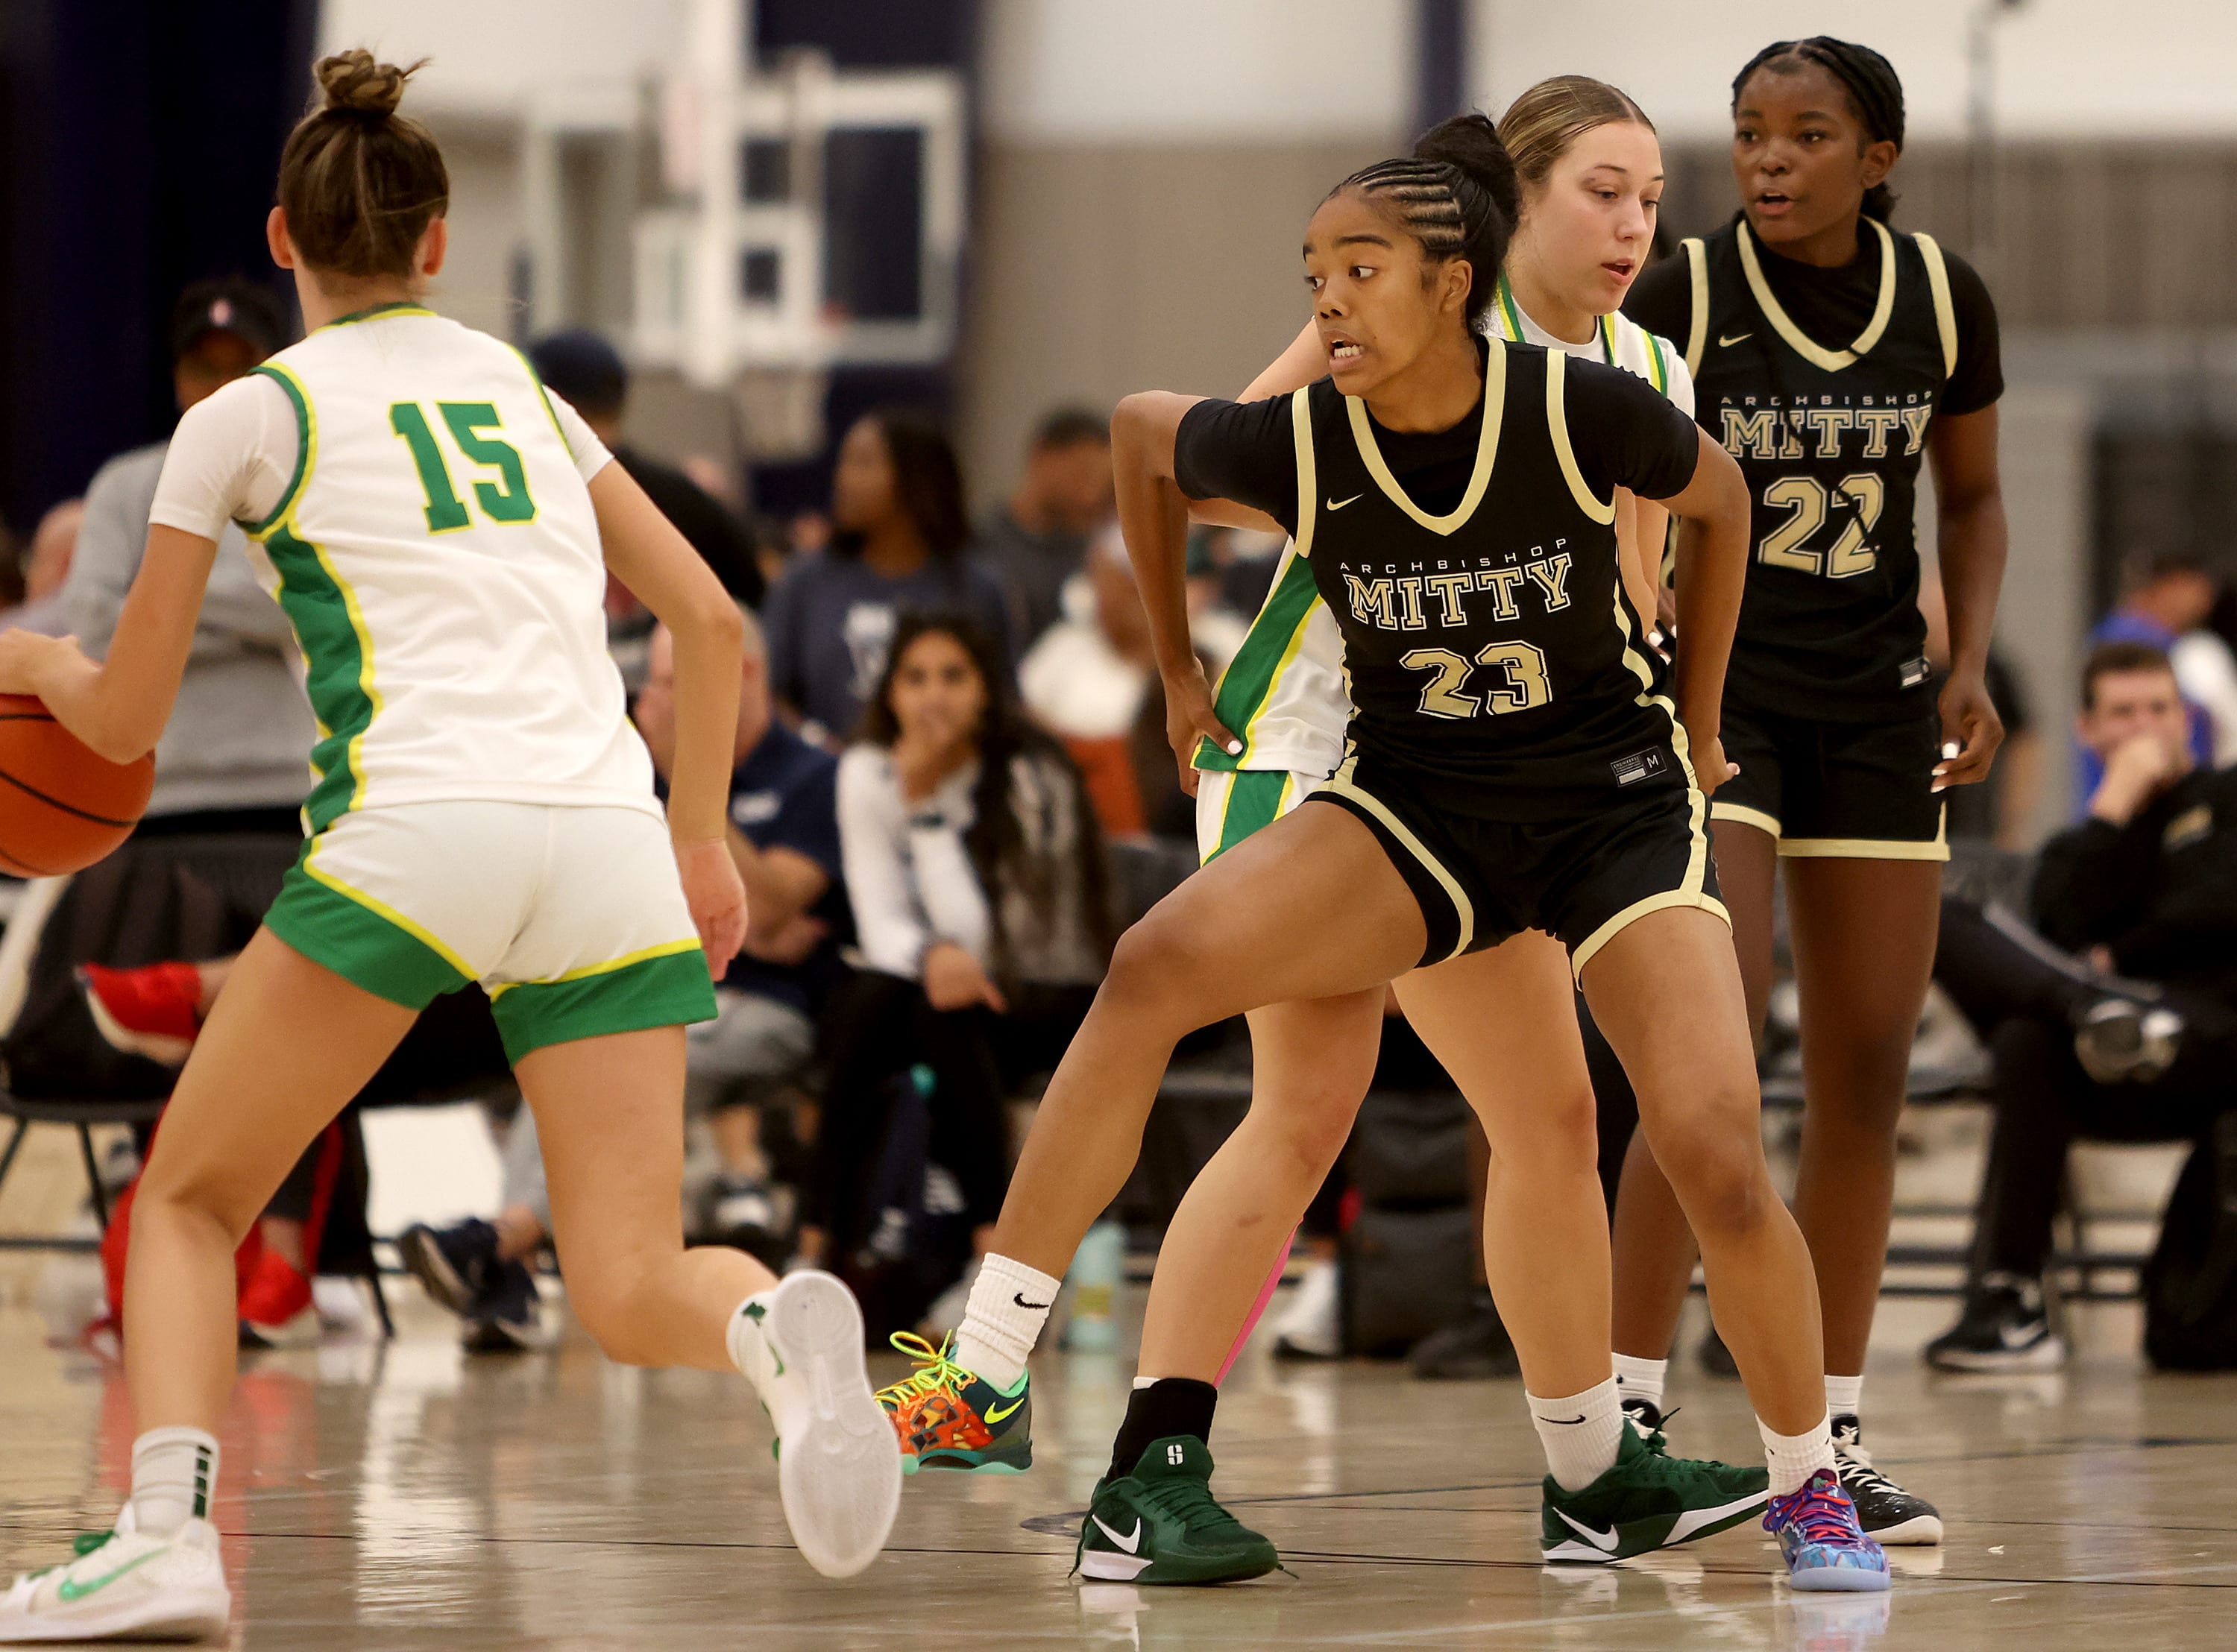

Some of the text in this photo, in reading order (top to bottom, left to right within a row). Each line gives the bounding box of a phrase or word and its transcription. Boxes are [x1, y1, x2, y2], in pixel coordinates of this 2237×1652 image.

[1720, 391, 1933, 406] ARCHBISHOP
[1720, 403, 1932, 460] MITTY
[387, 400, 541, 537] 15
[1339, 538, 1567, 574] ARCHBISHOP
[1758, 472, 1884, 578] 22
[1342, 552, 1573, 631] MITTY
[1399, 640, 1552, 719] 23
[1646, 754, 1659, 769] M
